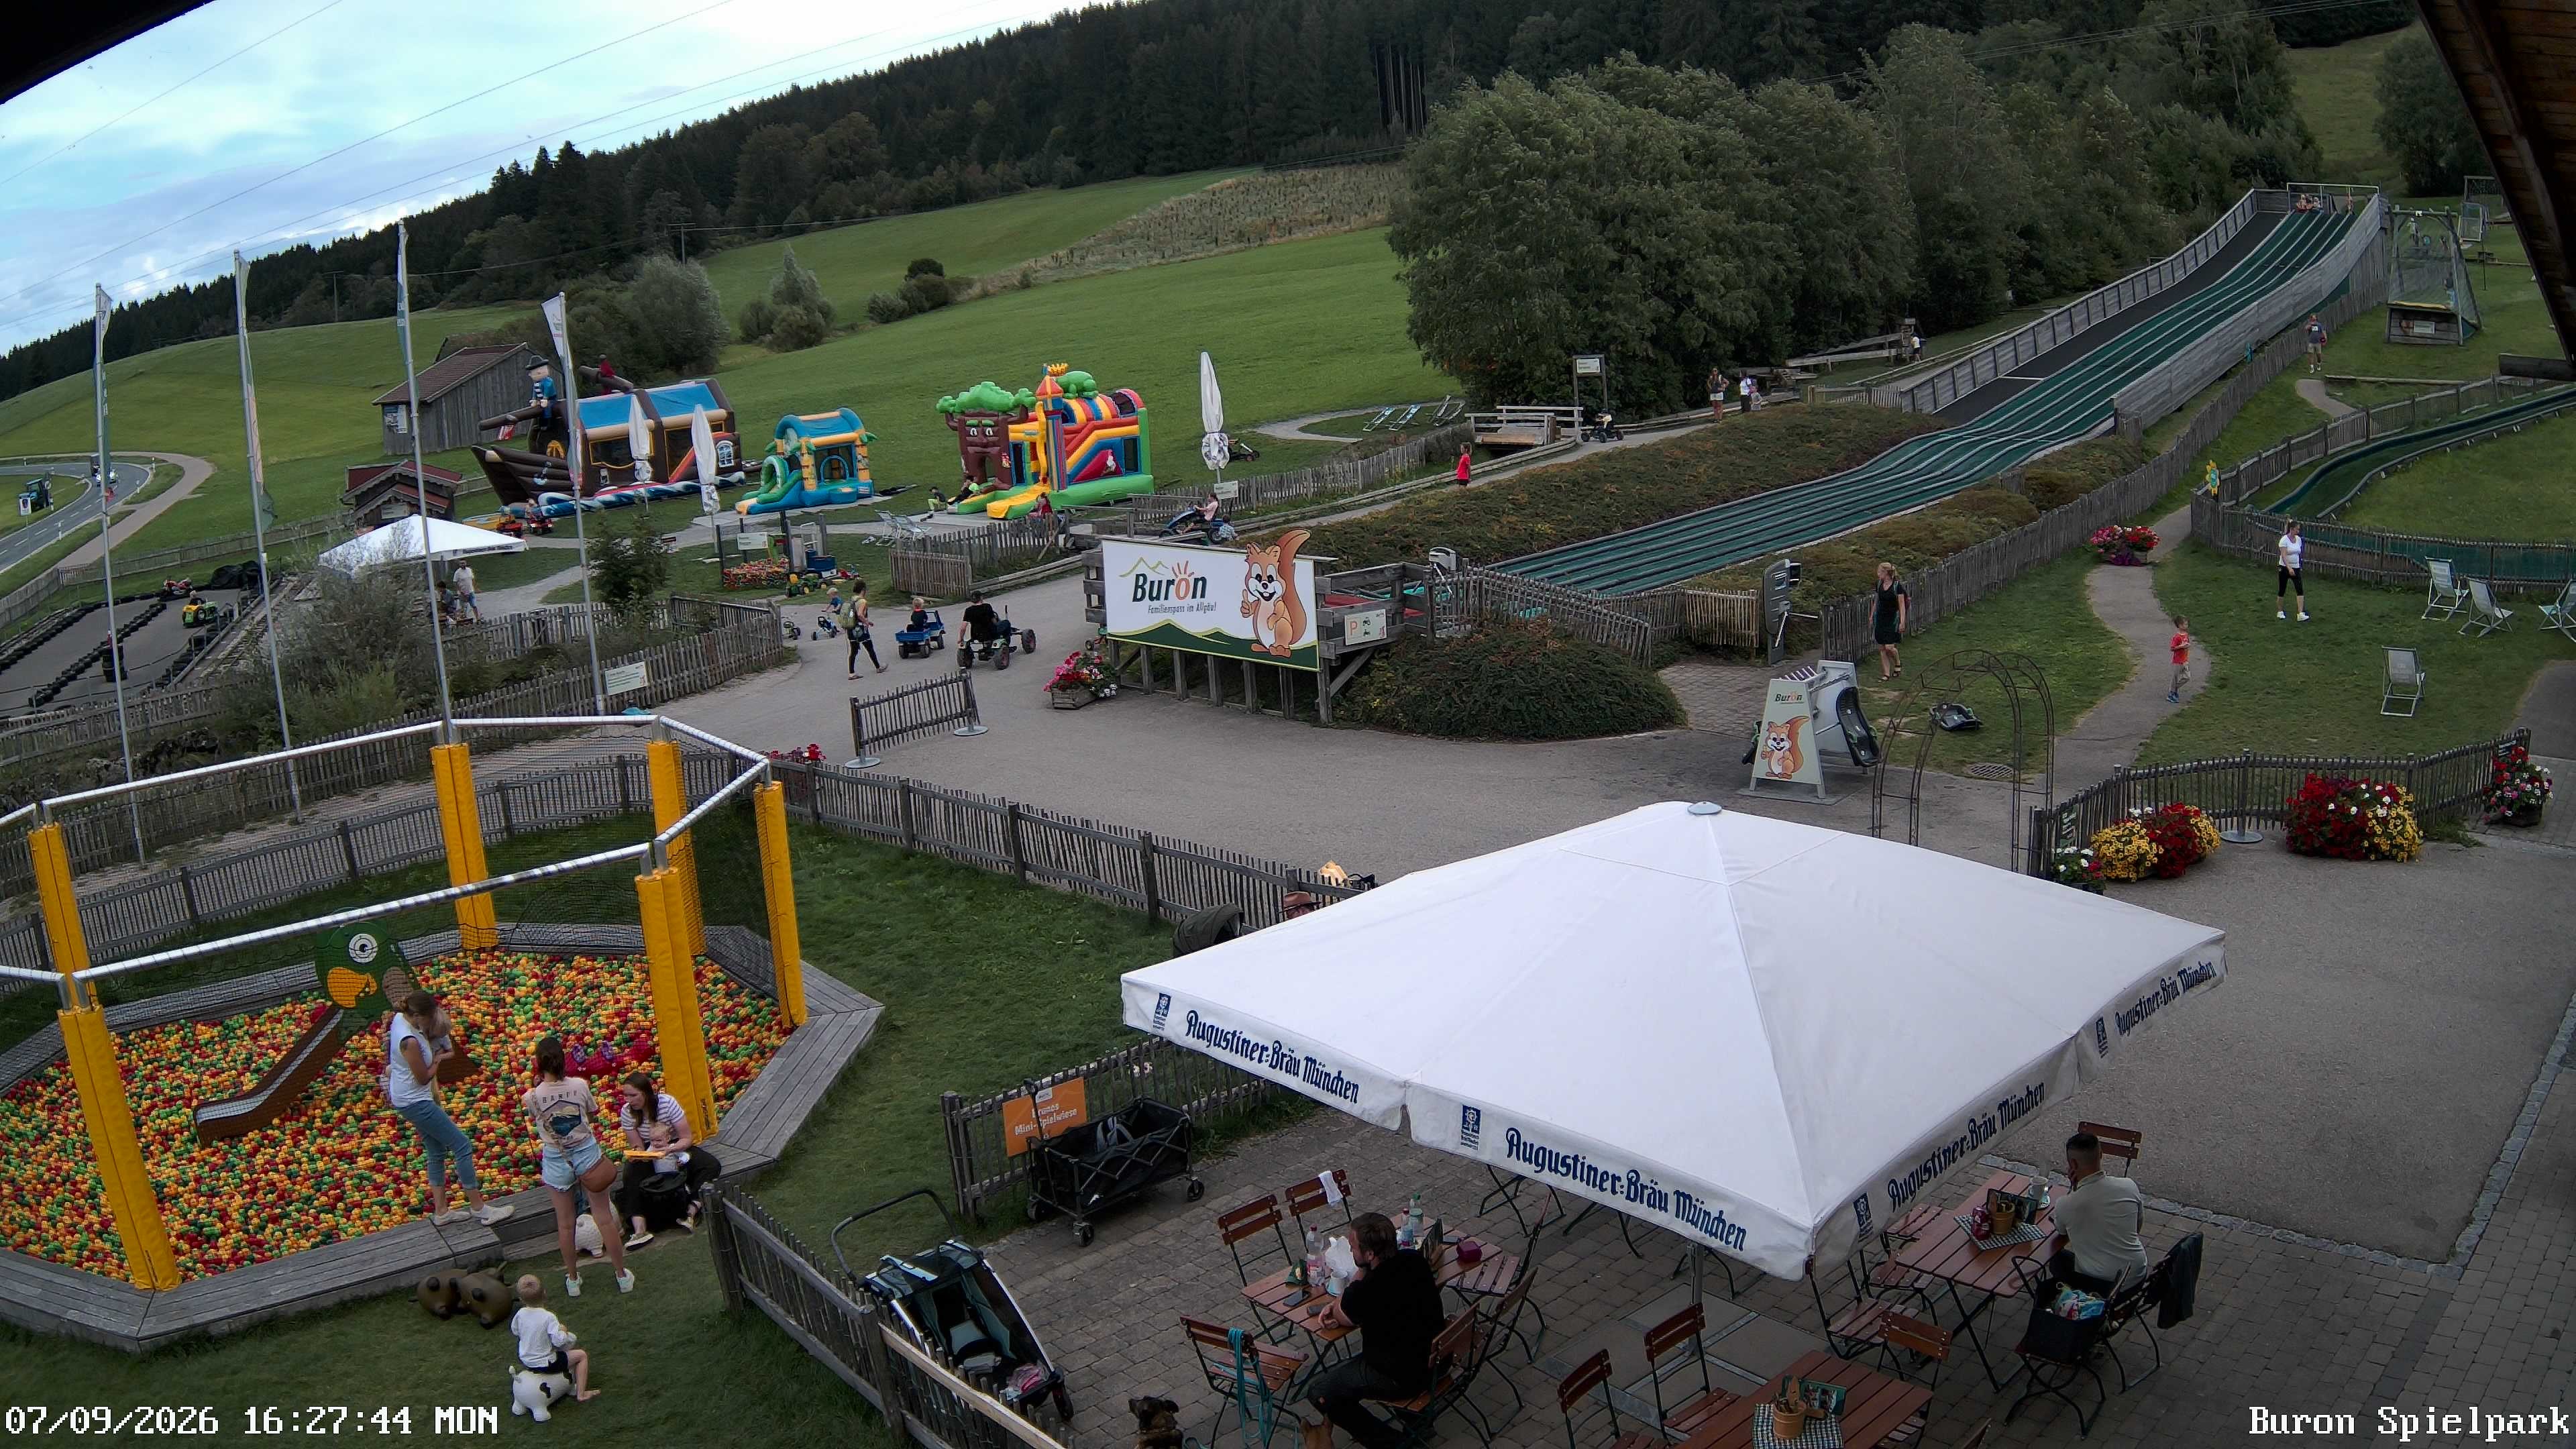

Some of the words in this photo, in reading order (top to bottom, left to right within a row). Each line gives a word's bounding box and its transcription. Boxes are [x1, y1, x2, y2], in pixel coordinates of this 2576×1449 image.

[1132, 573, 1208, 602] Buron
[1350, 621, 1358, 637] P
[1775, 694, 1803, 702] Buron
[1302, 1055, 1360, 1104] München
[1998, 1081, 2045, 1131] München
[1673, 1189, 1748, 1252] München
